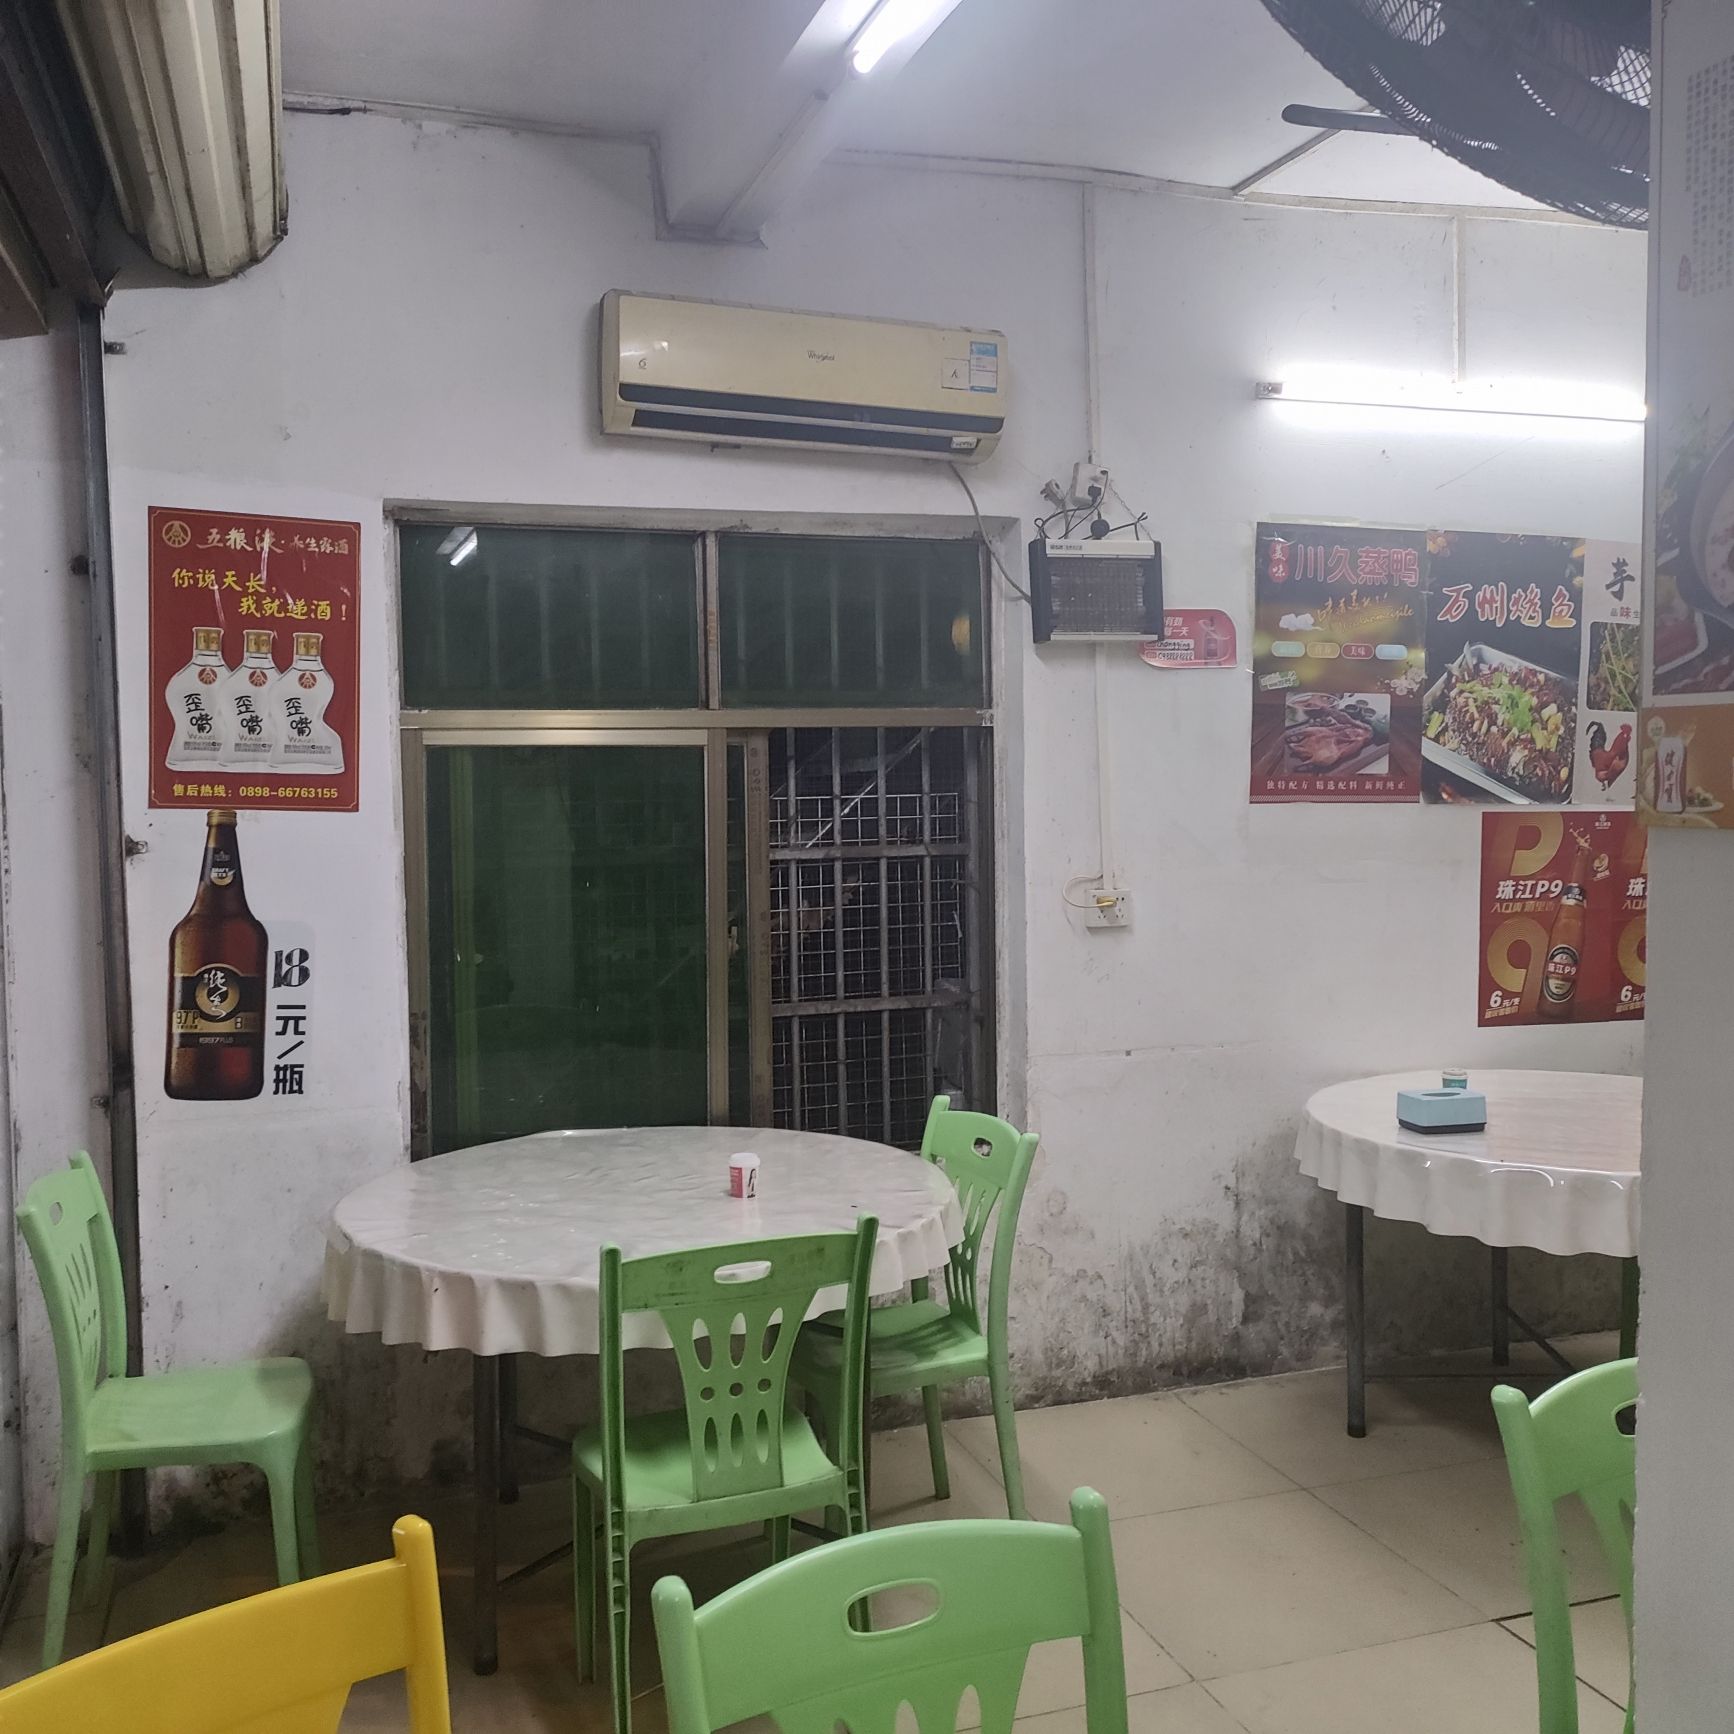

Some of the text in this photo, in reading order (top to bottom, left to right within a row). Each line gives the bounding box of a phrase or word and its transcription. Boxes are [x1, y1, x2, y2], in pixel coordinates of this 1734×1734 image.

[1272, 544, 1286, 577] 美味
[1295, 543, 1419, 588] 川久蒸鸭
[1605, 556, 1636, 602] 芋
[184, 693, 213, 734] 歪嘴
[234, 695, 263, 735] 歪嘴
[284, 697, 312, 737] 歪嘴
[1495, 879, 1563, 899] 珠江P9
[1626, 877, 1647, 897] 珠
